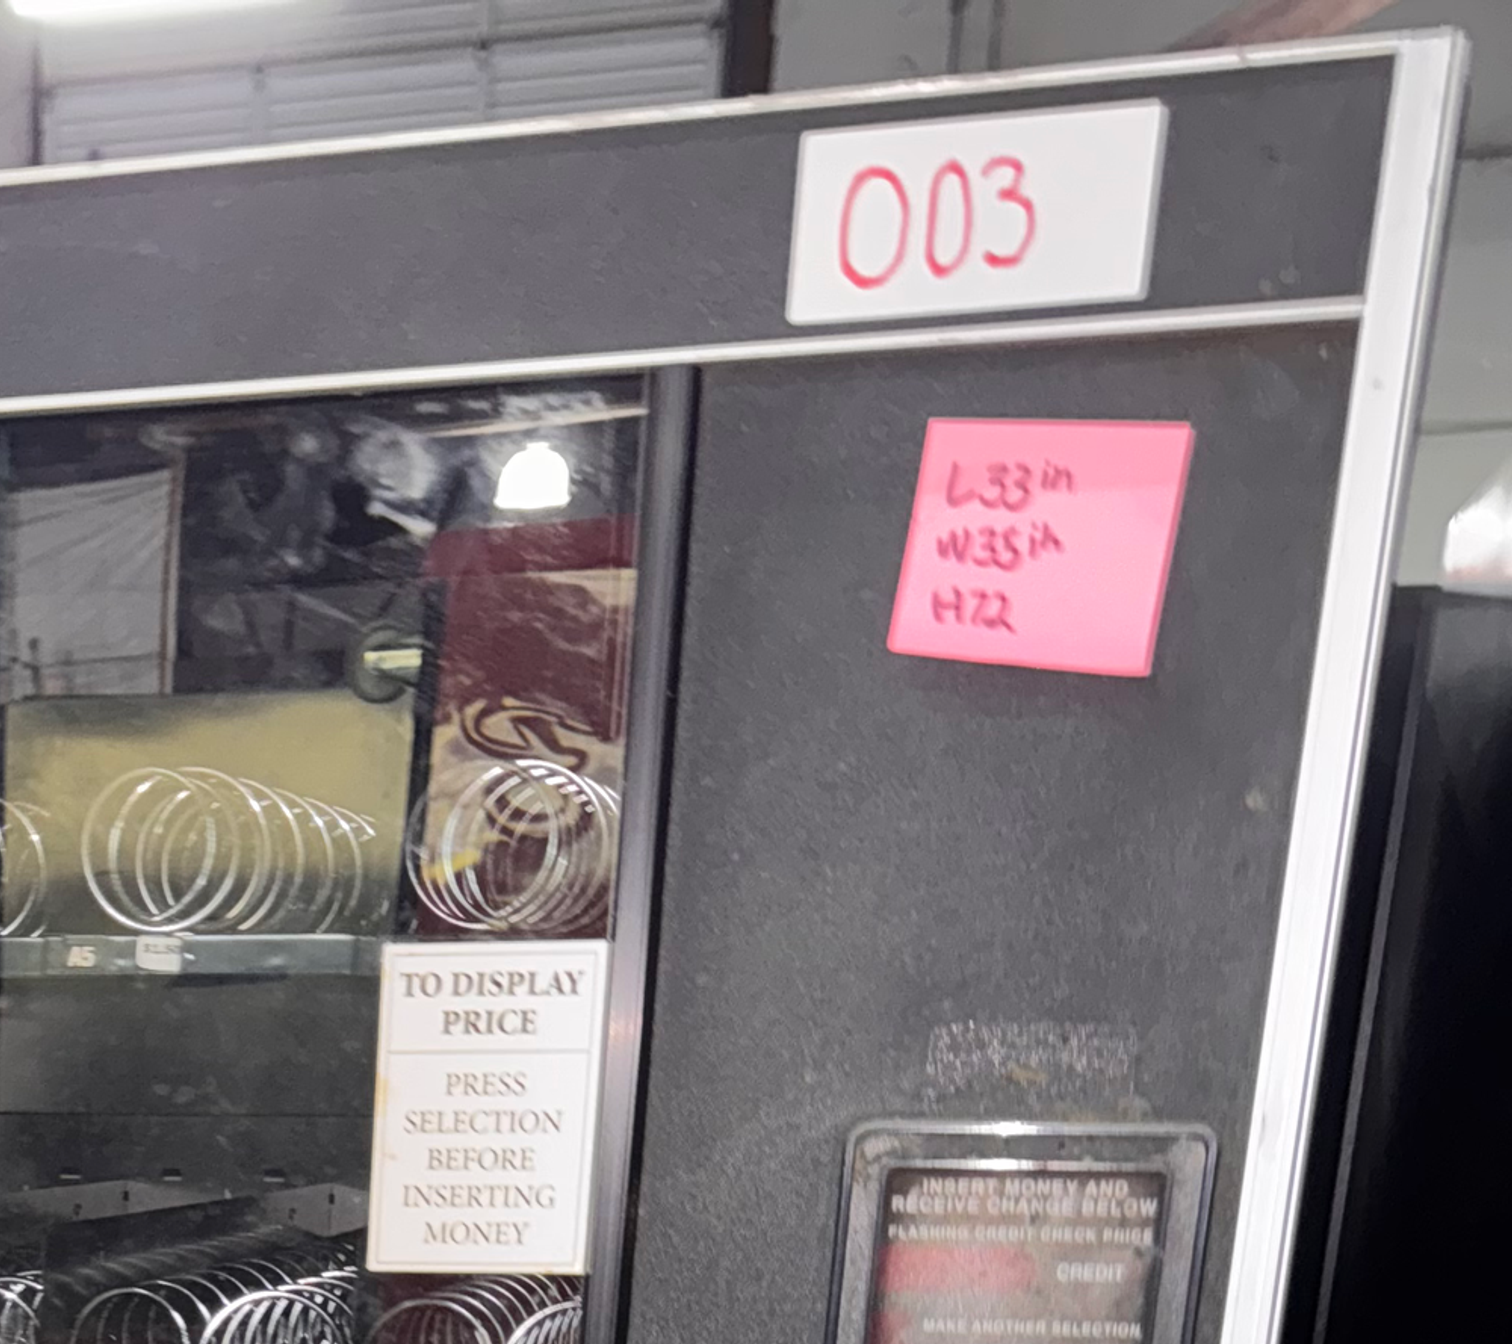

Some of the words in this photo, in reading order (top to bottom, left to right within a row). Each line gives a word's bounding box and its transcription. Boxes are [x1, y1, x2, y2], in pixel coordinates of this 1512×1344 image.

[399, 971, 442, 997] TO
[451, 969, 585, 998] DISPLAY
[441, 1009, 538, 1036] PRICE
[445, 1071, 527, 1097] PRESS
[403, 1109, 563, 1135] SELECTION
[426, 1147, 536, 1172] BEFORE
[402, 1183, 556, 1210] INSERTING
[922, 1176, 998, 1196] INSERT
[1004, 1177, 1079, 1198] MONEY
[1084, 1178, 1130, 1199] AND
[890, 1194, 982, 1214] RECEIVE
[987, 1195, 1076, 1217] CHANGE
[1081, 1197, 1159, 1218] BELOW
[423, 1221, 529, 1247] MONEY
[1055, 1260, 1126, 1284] CREDIT
[922, 1317, 969, 1335] MAKE
[971, 1318, 1046, 1338] ANOTHER
